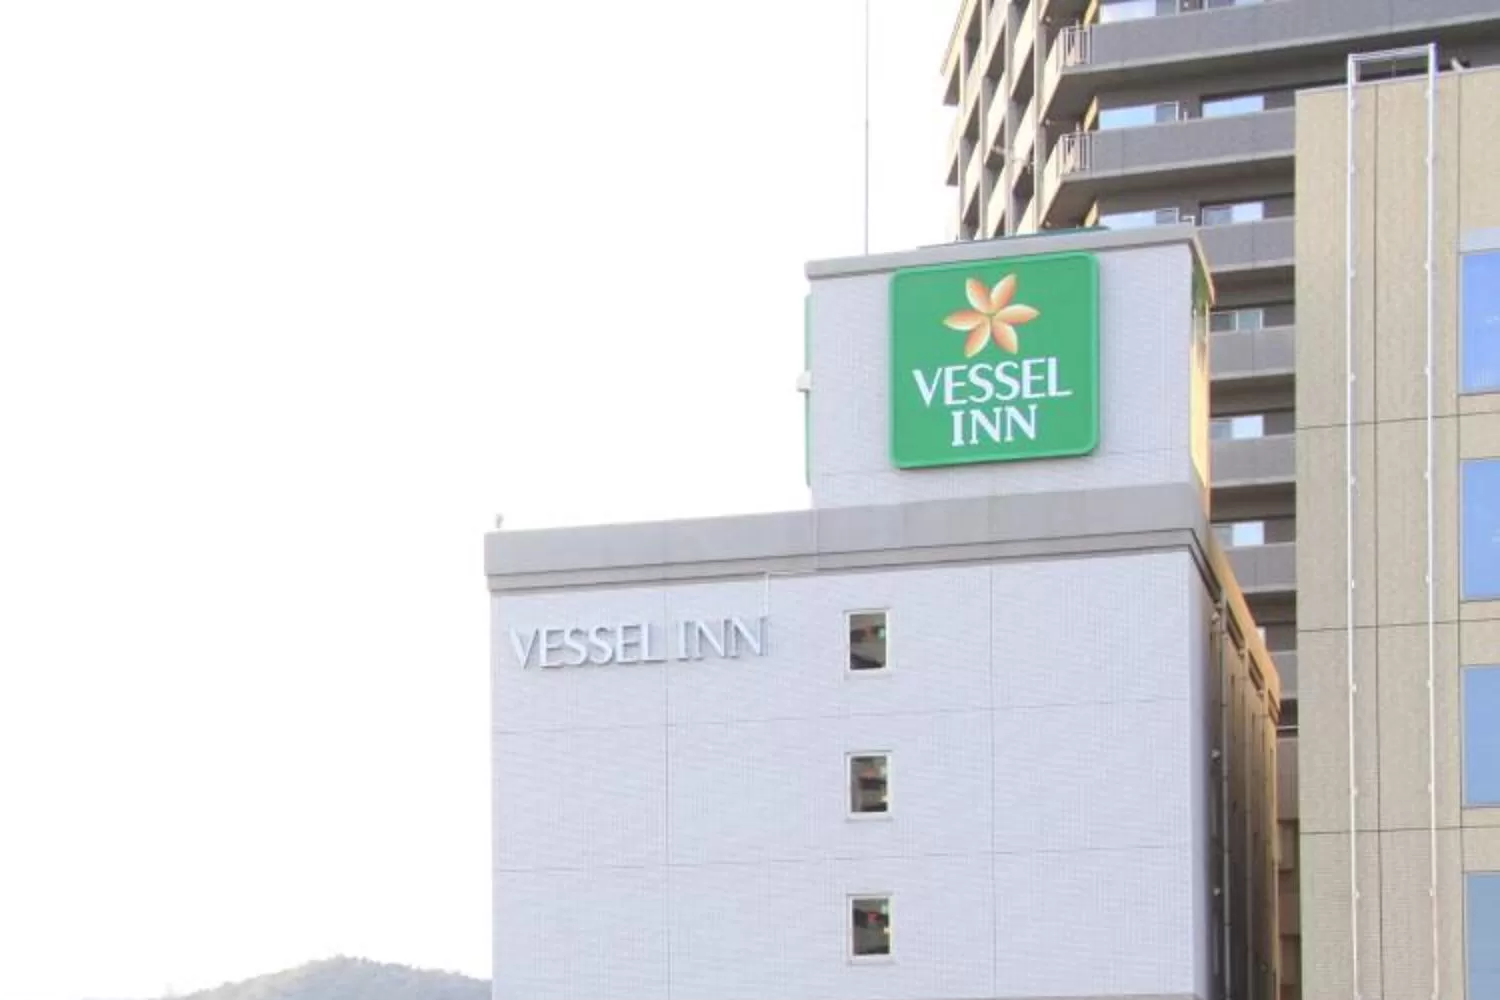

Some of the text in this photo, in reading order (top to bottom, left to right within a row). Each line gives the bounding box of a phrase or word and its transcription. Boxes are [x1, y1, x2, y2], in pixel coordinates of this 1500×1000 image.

[912, 356, 1074, 409] VESSEL
[951, 393, 1039, 447] INN
[509, 615, 768, 670] VESSEL INN
